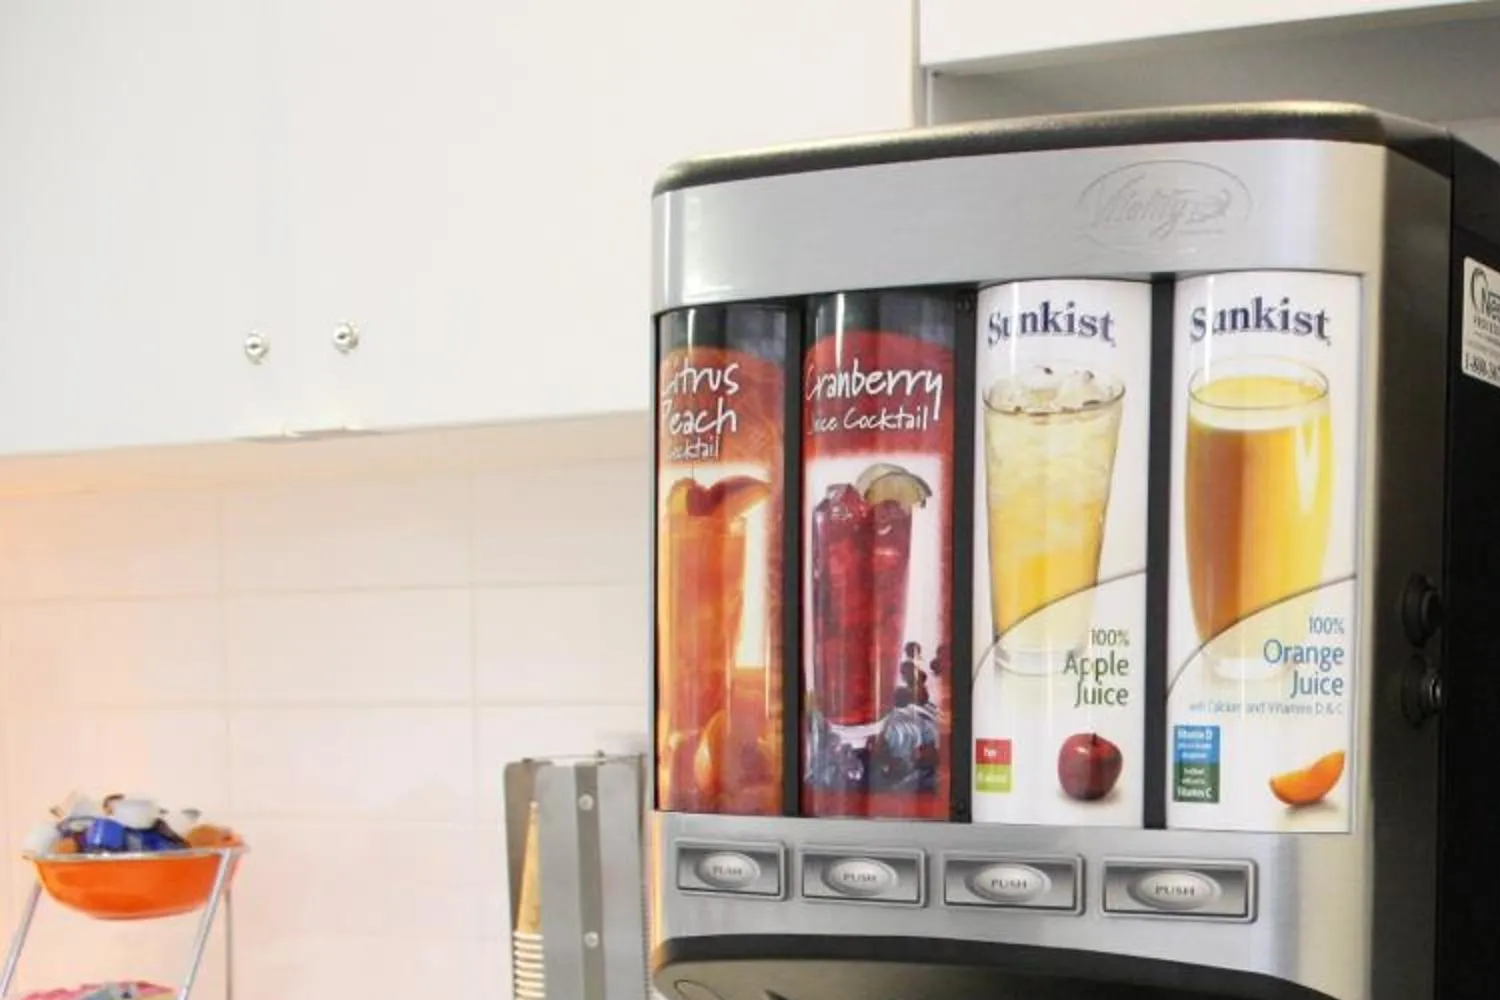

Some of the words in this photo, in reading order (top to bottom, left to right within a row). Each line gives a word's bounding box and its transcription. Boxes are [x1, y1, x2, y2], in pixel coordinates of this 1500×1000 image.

[988, 300, 1116, 348] Sunkist
[1189, 297, 1331, 343] Sunkist
[806, 358, 943, 421] Cranberry
[843, 405, 928, 431] Cocktail
[1091, 628, 1130, 647] 100%
[1309, 616, 1344, 635] 100%
[1063, 650, 1130, 683] Apple
[1263, 638, 1345, 672] Orange
[1074, 682, 1130, 708] Juice
[1290, 670, 1344, 698] Juice
[842, 872, 877, 882] PUSH
[991, 878, 1027, 889] PUSH
[1155, 884, 1195, 896] PUSH
